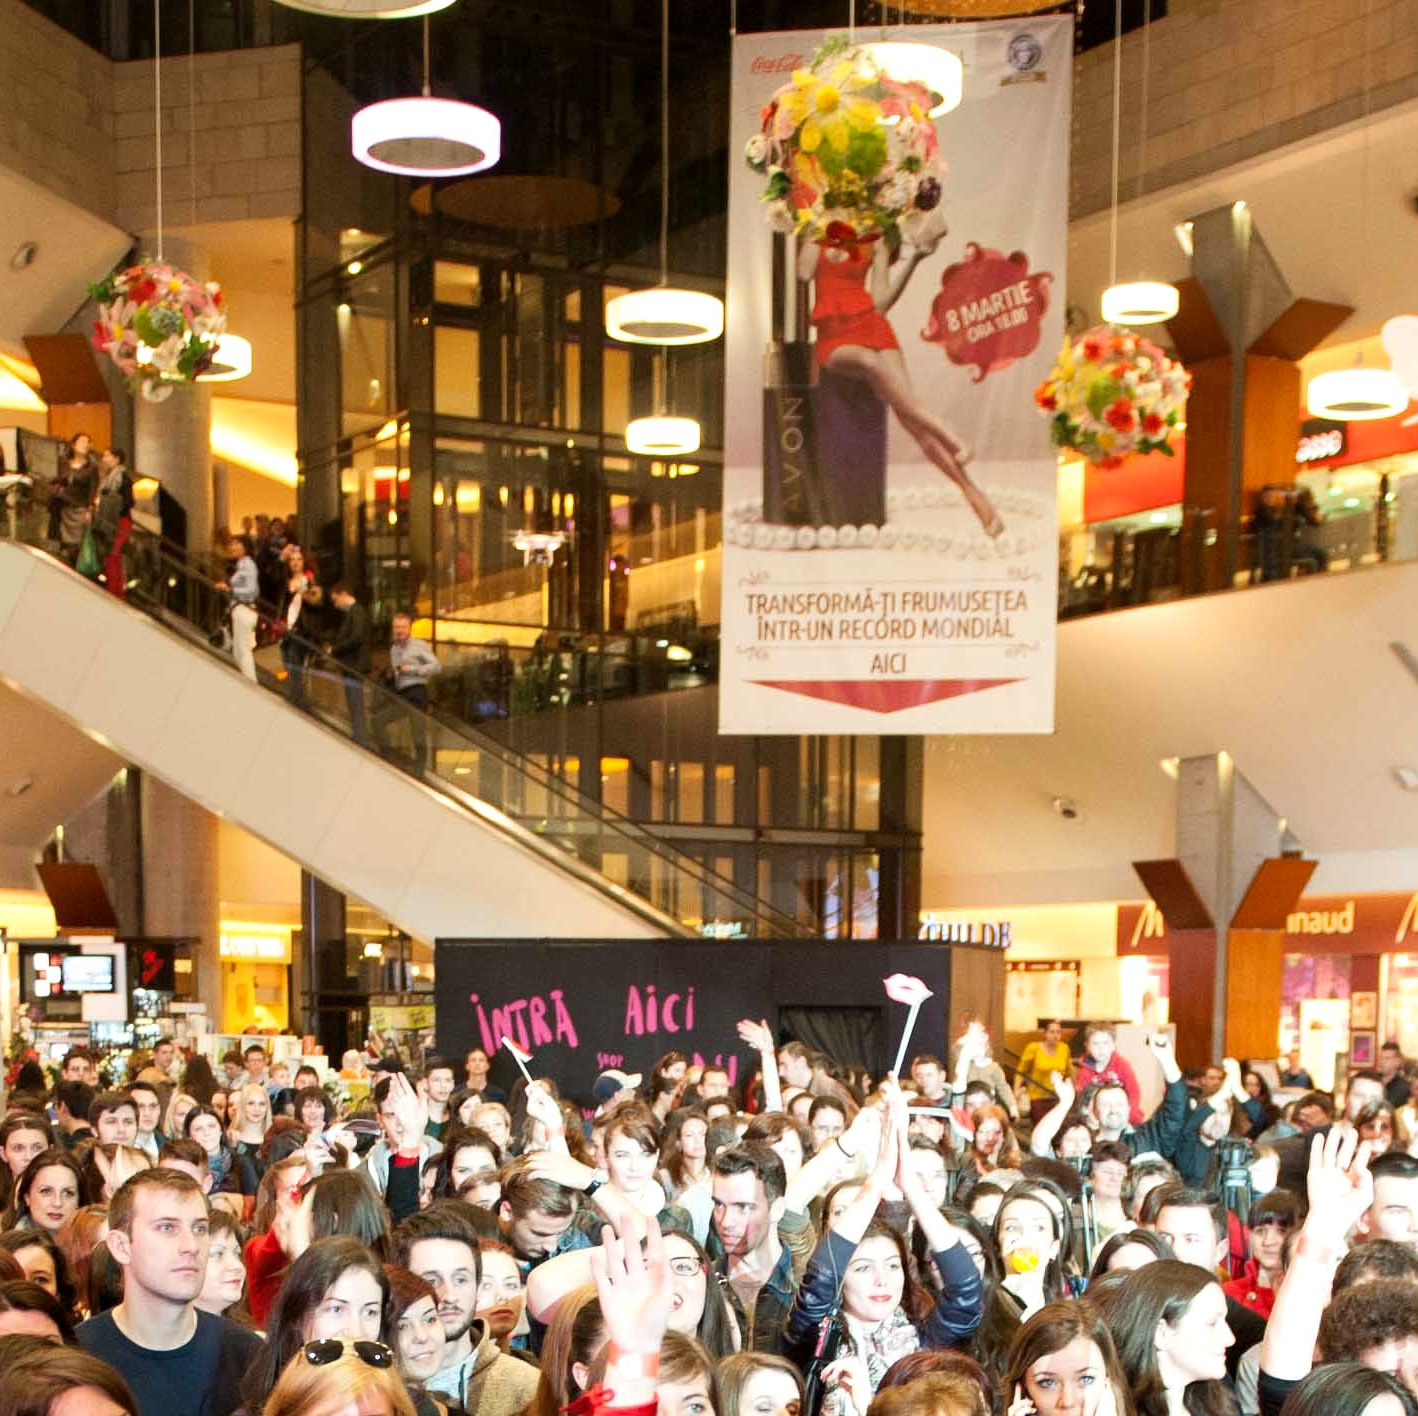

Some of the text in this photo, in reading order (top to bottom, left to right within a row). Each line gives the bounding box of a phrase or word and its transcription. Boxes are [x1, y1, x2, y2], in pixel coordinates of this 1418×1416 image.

[945, 280, 1034, 332] 8 MARTIE
[966, 320, 996, 343] ORA
[782, 397, 804, 512] AVON
[757, 616, 1014, 641] ÎNTR-UN RECORD MONDIAL
[870, 652, 907, 675] AICI
